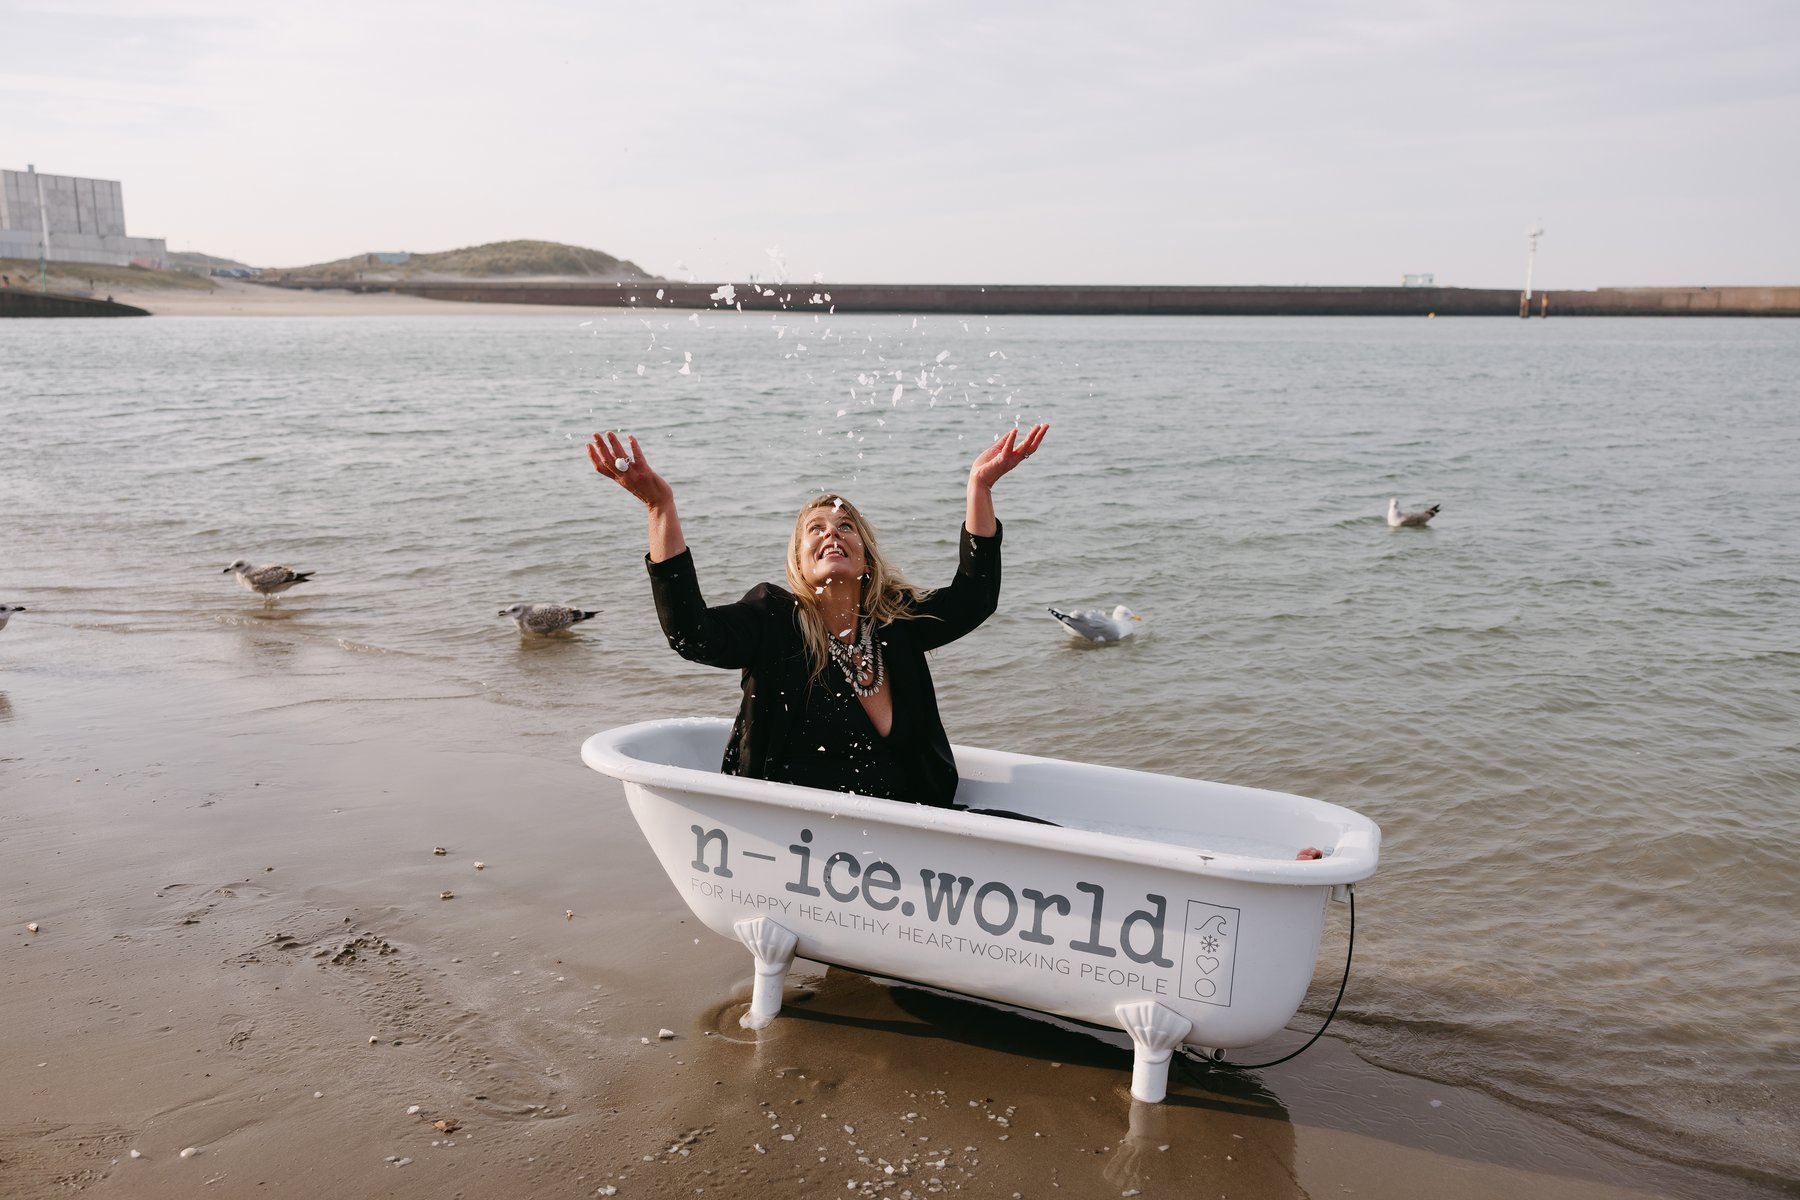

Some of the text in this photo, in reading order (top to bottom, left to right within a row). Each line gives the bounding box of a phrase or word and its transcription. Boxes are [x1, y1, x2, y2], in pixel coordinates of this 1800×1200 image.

[691, 877, 1168, 995] FOR HAPPY HEALTHY HEARTWORKING PEOPLE
